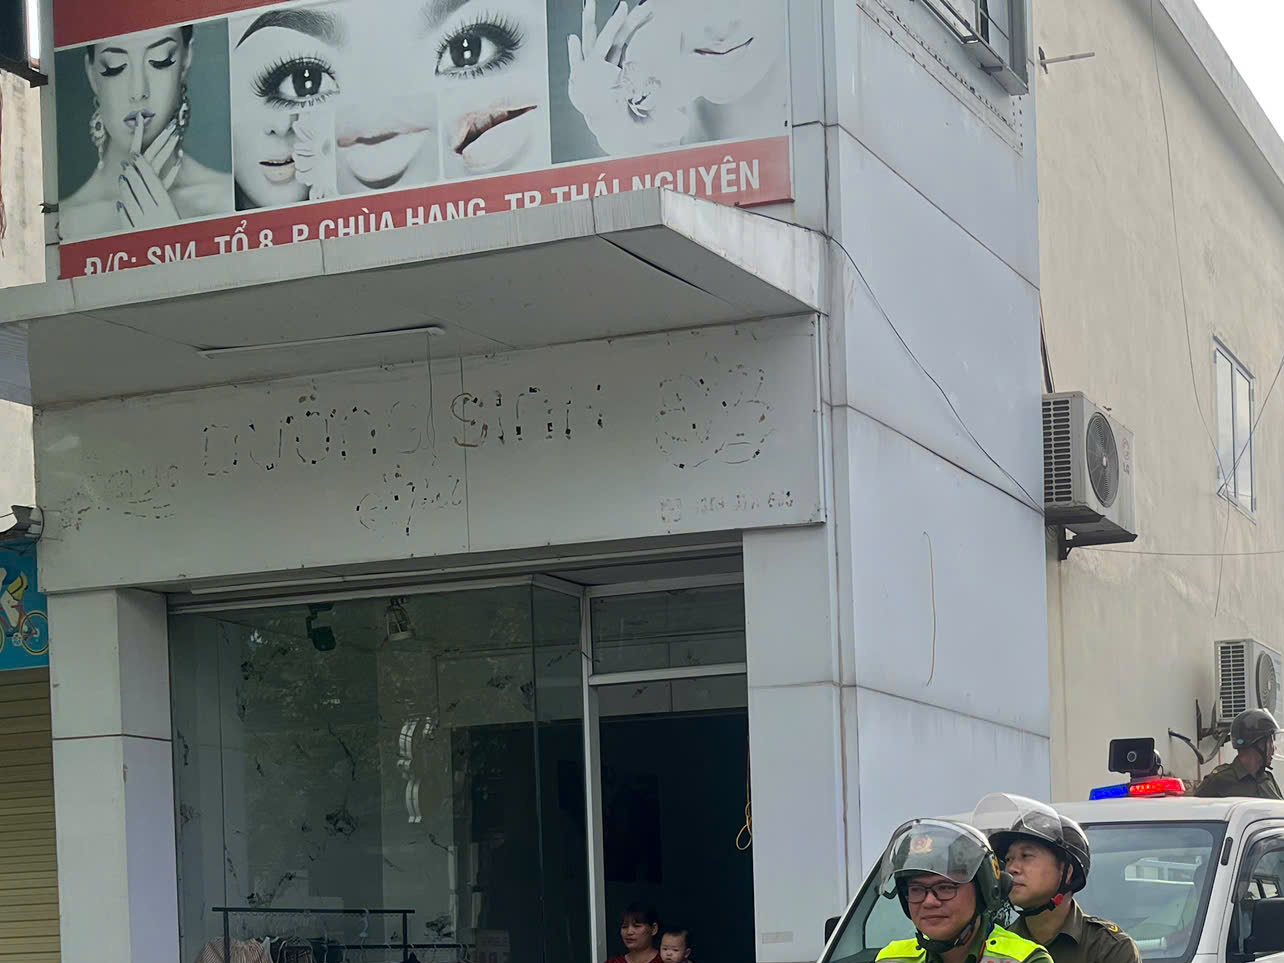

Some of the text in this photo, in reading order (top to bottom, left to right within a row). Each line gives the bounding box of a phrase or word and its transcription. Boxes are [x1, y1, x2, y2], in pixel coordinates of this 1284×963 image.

[214, 219, 249, 254] TỔ
[318, 208, 395, 240] CHÙA
[631, 155, 760, 196] NGUYÊN
